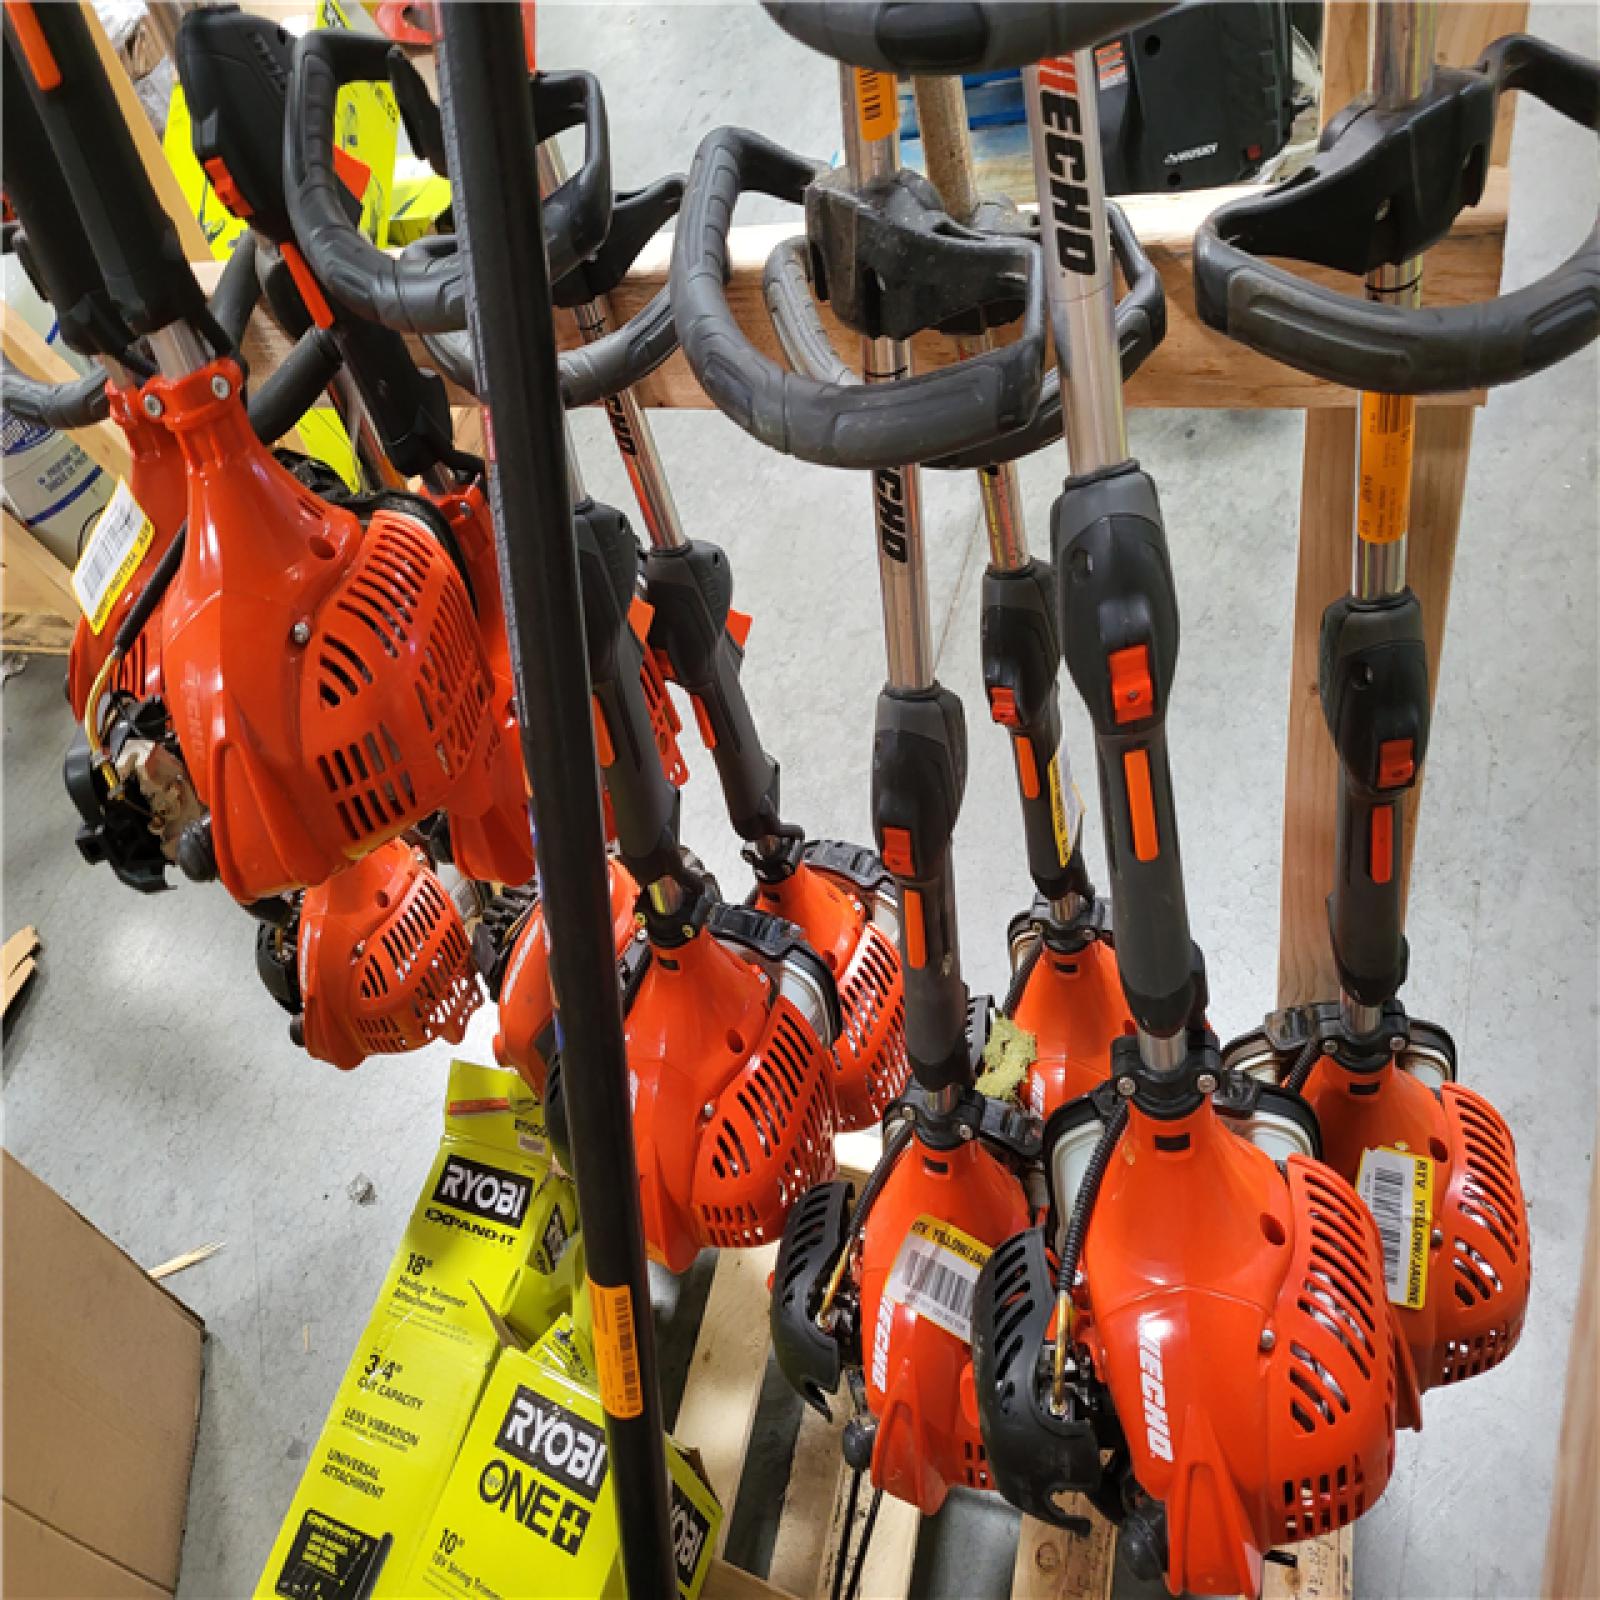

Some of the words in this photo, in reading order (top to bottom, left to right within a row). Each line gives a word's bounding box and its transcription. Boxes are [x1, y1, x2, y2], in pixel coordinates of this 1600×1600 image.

[1040, 90, 1096, 276] ECHO
[604, 393, 637, 456] CHO
[877, 467, 907, 563] CHO
[441, 1164, 526, 1219] RYOBI
[505, 1397, 608, 1487] RYOBI
[1139, 1345, 1175, 1463] ECHO
